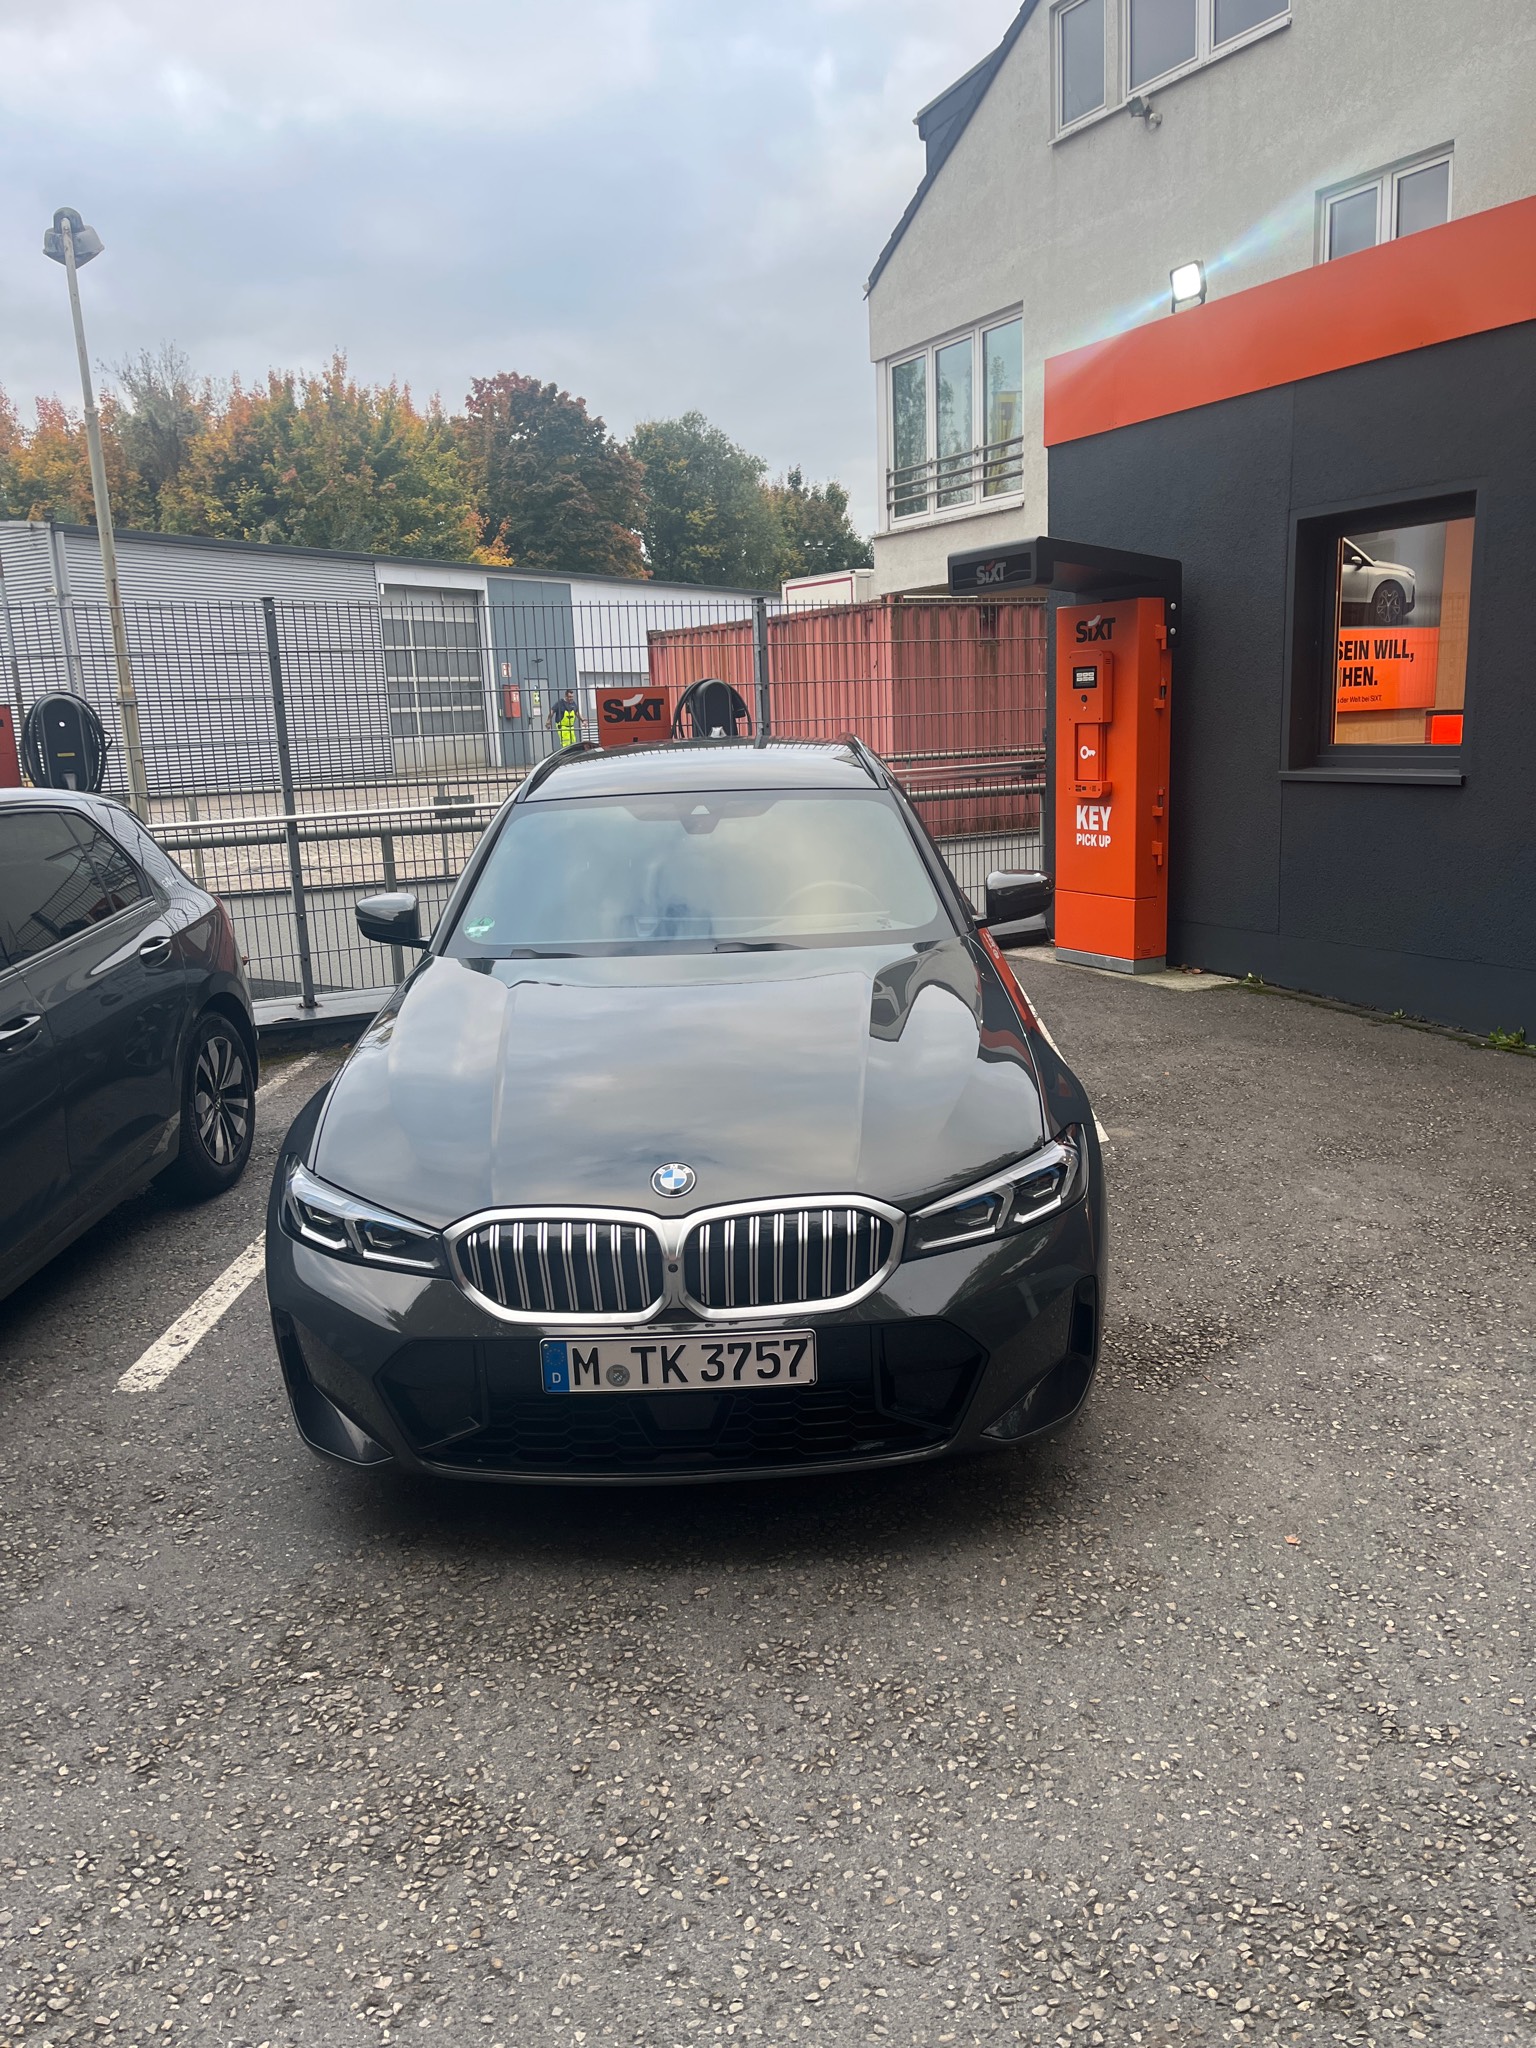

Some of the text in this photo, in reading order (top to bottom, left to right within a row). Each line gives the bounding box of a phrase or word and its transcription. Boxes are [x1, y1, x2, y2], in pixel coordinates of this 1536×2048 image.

[975, 560, 1007, 585] SIXT
[1075, 615, 1116, 643] SIXT
[1374, 639, 1415, 662] WILL,
[1339, 666, 1378, 687] HEN.
[603, 693, 664, 723] SIXT
[1362, 695, 1370, 703] bei
[1076, 804, 1112, 831] KEY
[1076, 833, 1111, 848] PICK UP
[572, 1339, 808, 1385] M TK 3757
[552, 1372, 561, 1384] D
